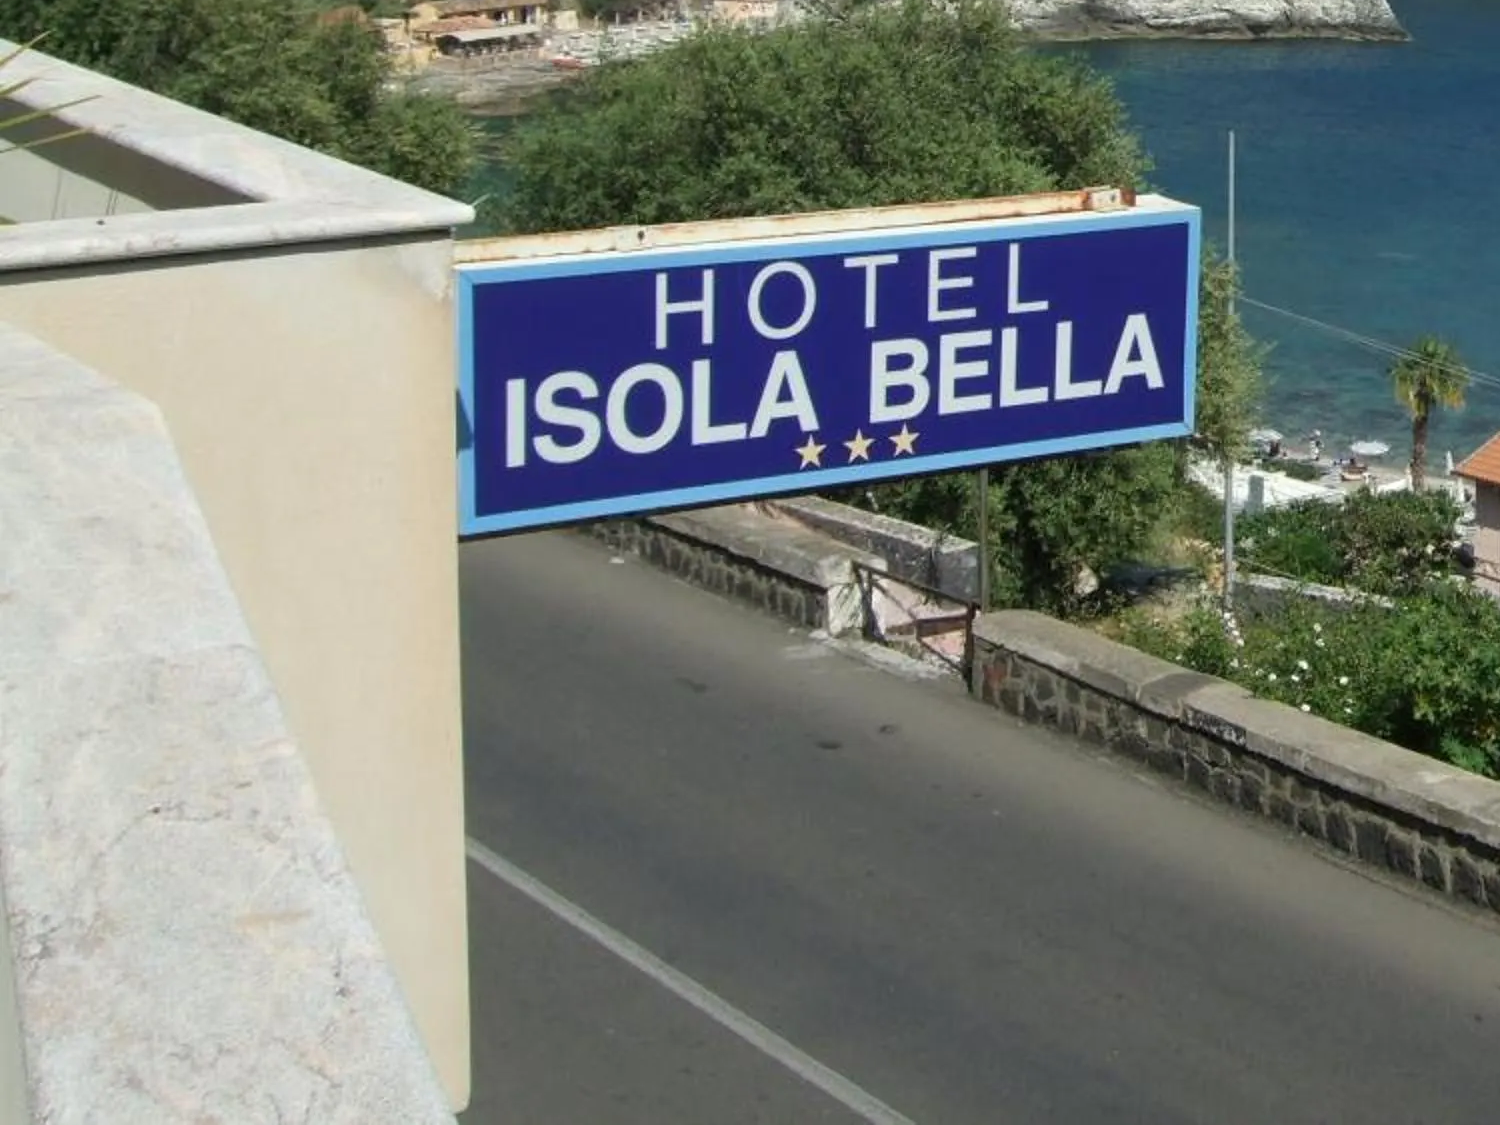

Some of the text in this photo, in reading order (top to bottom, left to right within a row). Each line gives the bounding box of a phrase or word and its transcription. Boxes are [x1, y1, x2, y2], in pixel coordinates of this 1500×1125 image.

[655, 243, 1049, 350] HOTEL
[506, 313, 1164, 468] ISOLA BELLA
